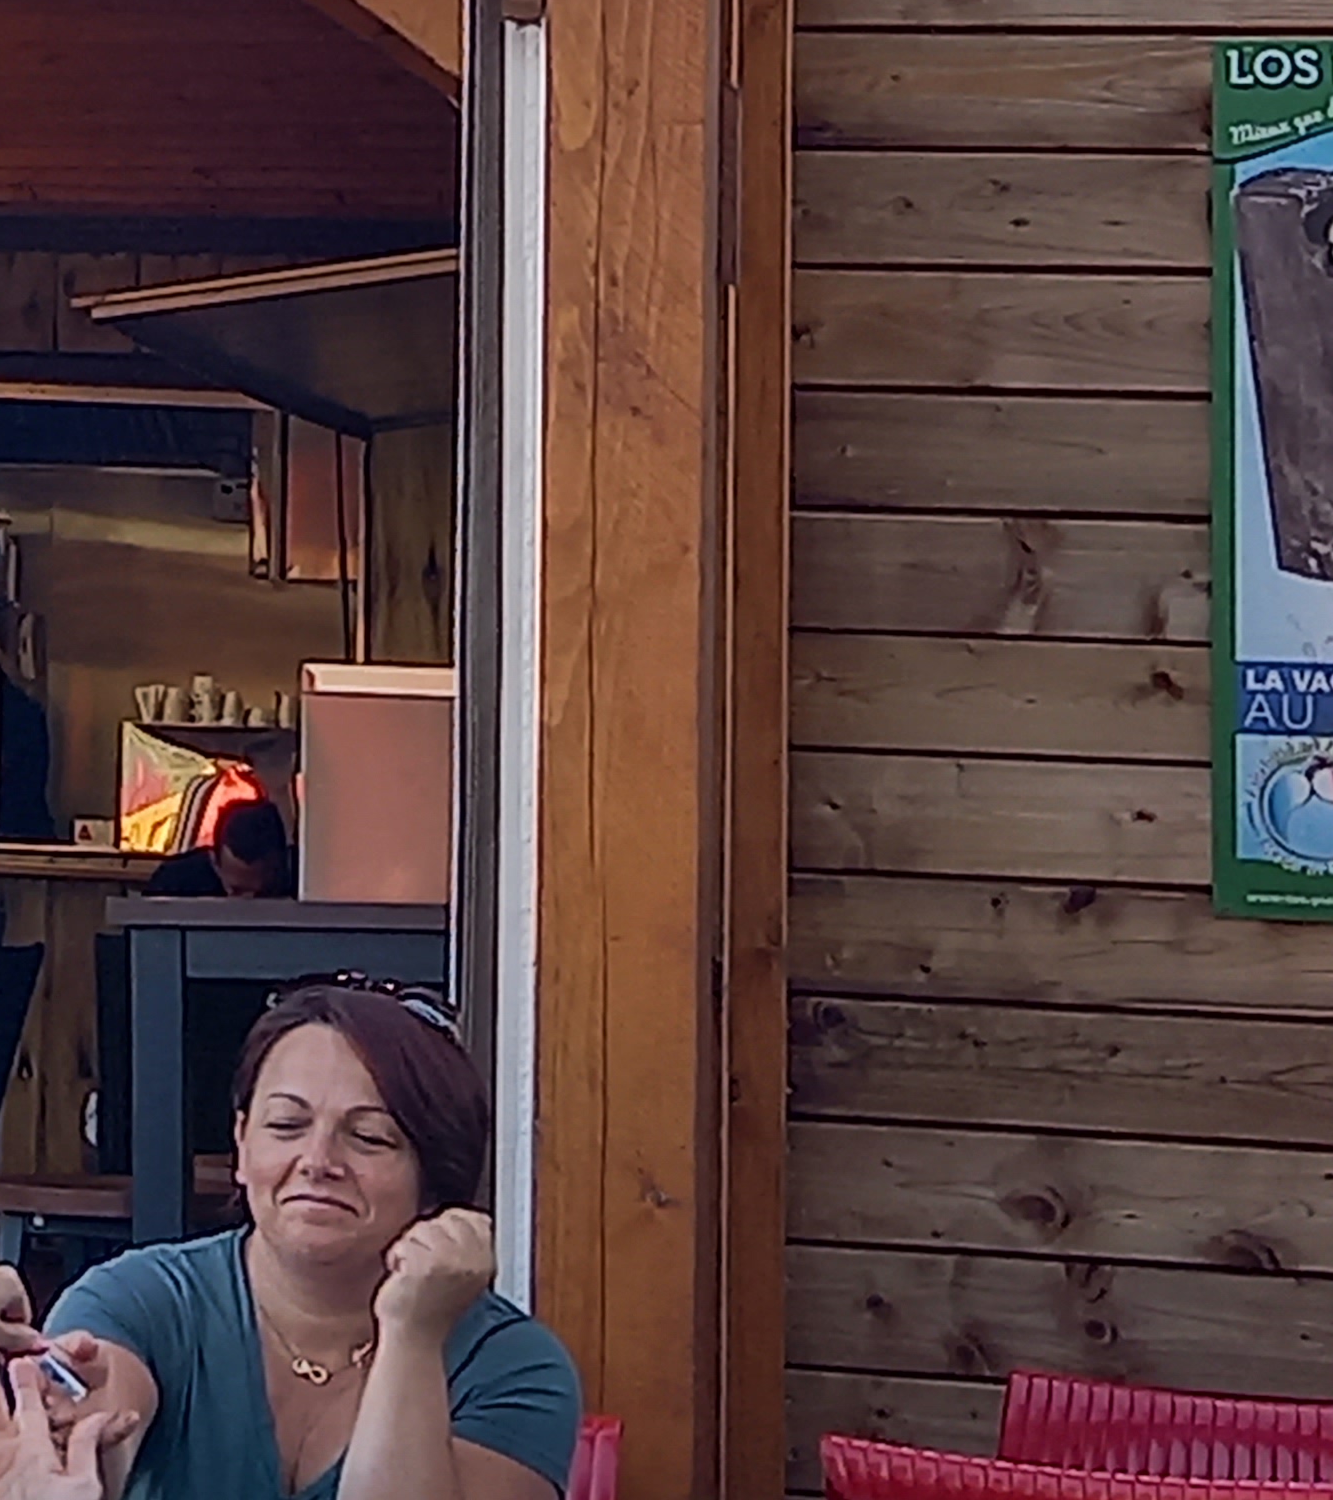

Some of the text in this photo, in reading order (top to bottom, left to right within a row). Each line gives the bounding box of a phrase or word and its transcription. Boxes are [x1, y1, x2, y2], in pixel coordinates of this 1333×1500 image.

[1225, 47, 1320, 88] LOS
[1245, 669, 1333, 693] LA VA
[1243, 693, 1313, 730] AU
